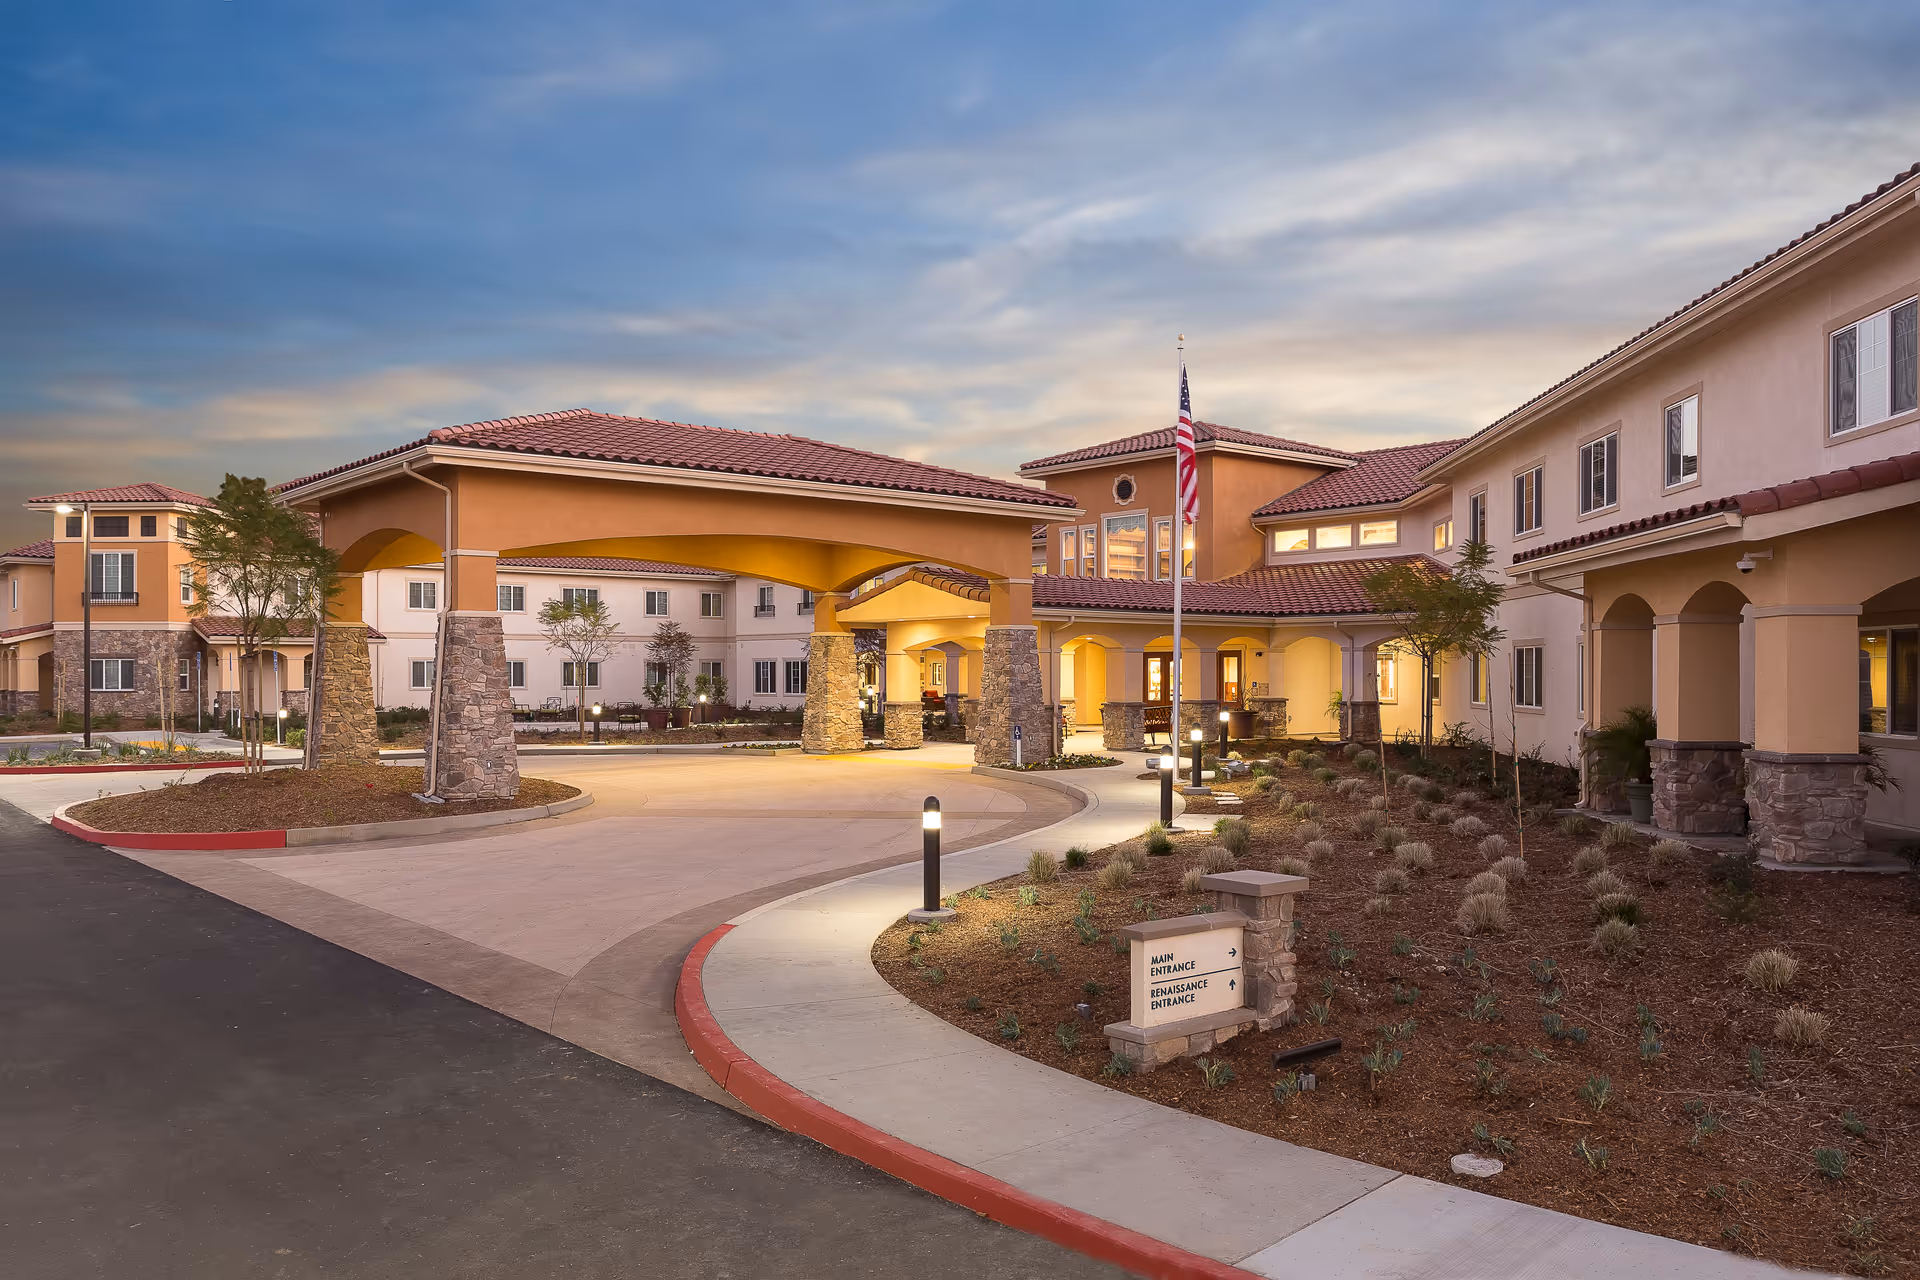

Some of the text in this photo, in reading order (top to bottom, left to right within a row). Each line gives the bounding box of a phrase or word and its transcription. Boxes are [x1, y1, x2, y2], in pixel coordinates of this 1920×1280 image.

[1150, 953, 1174, 965] MAIN
[1150, 961, 1196, 976] ENTRANCE
[1150, 979, 1208, 998] RENAISSANCE
[1151, 993, 1196, 1010] ENTRANCE
